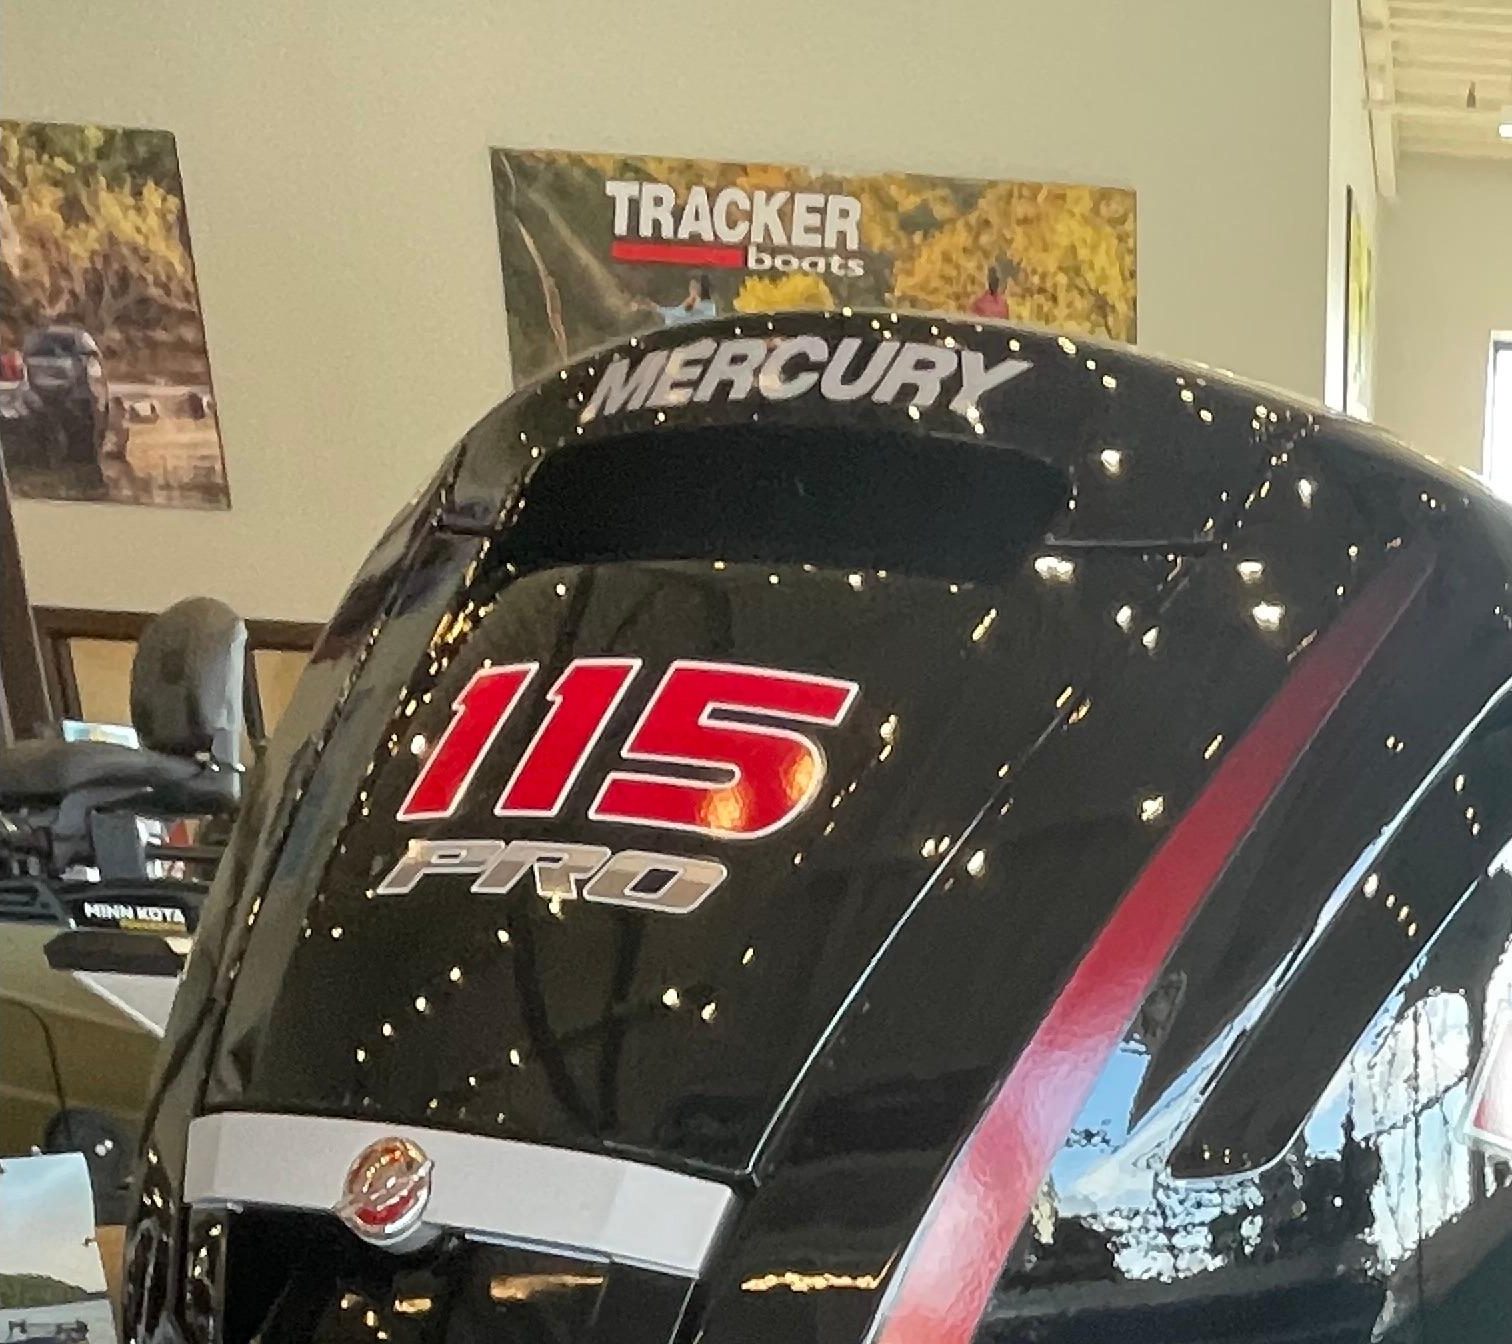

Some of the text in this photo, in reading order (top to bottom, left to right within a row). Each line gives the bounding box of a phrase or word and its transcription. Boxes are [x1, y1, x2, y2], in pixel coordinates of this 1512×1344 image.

[605, 181, 862, 250] TRACKER
[747, 246, 865, 277] boats
[580, 336, 1034, 423] MERCURY
[396, 658, 860, 839] 115
[377, 839, 728, 913] PRO
